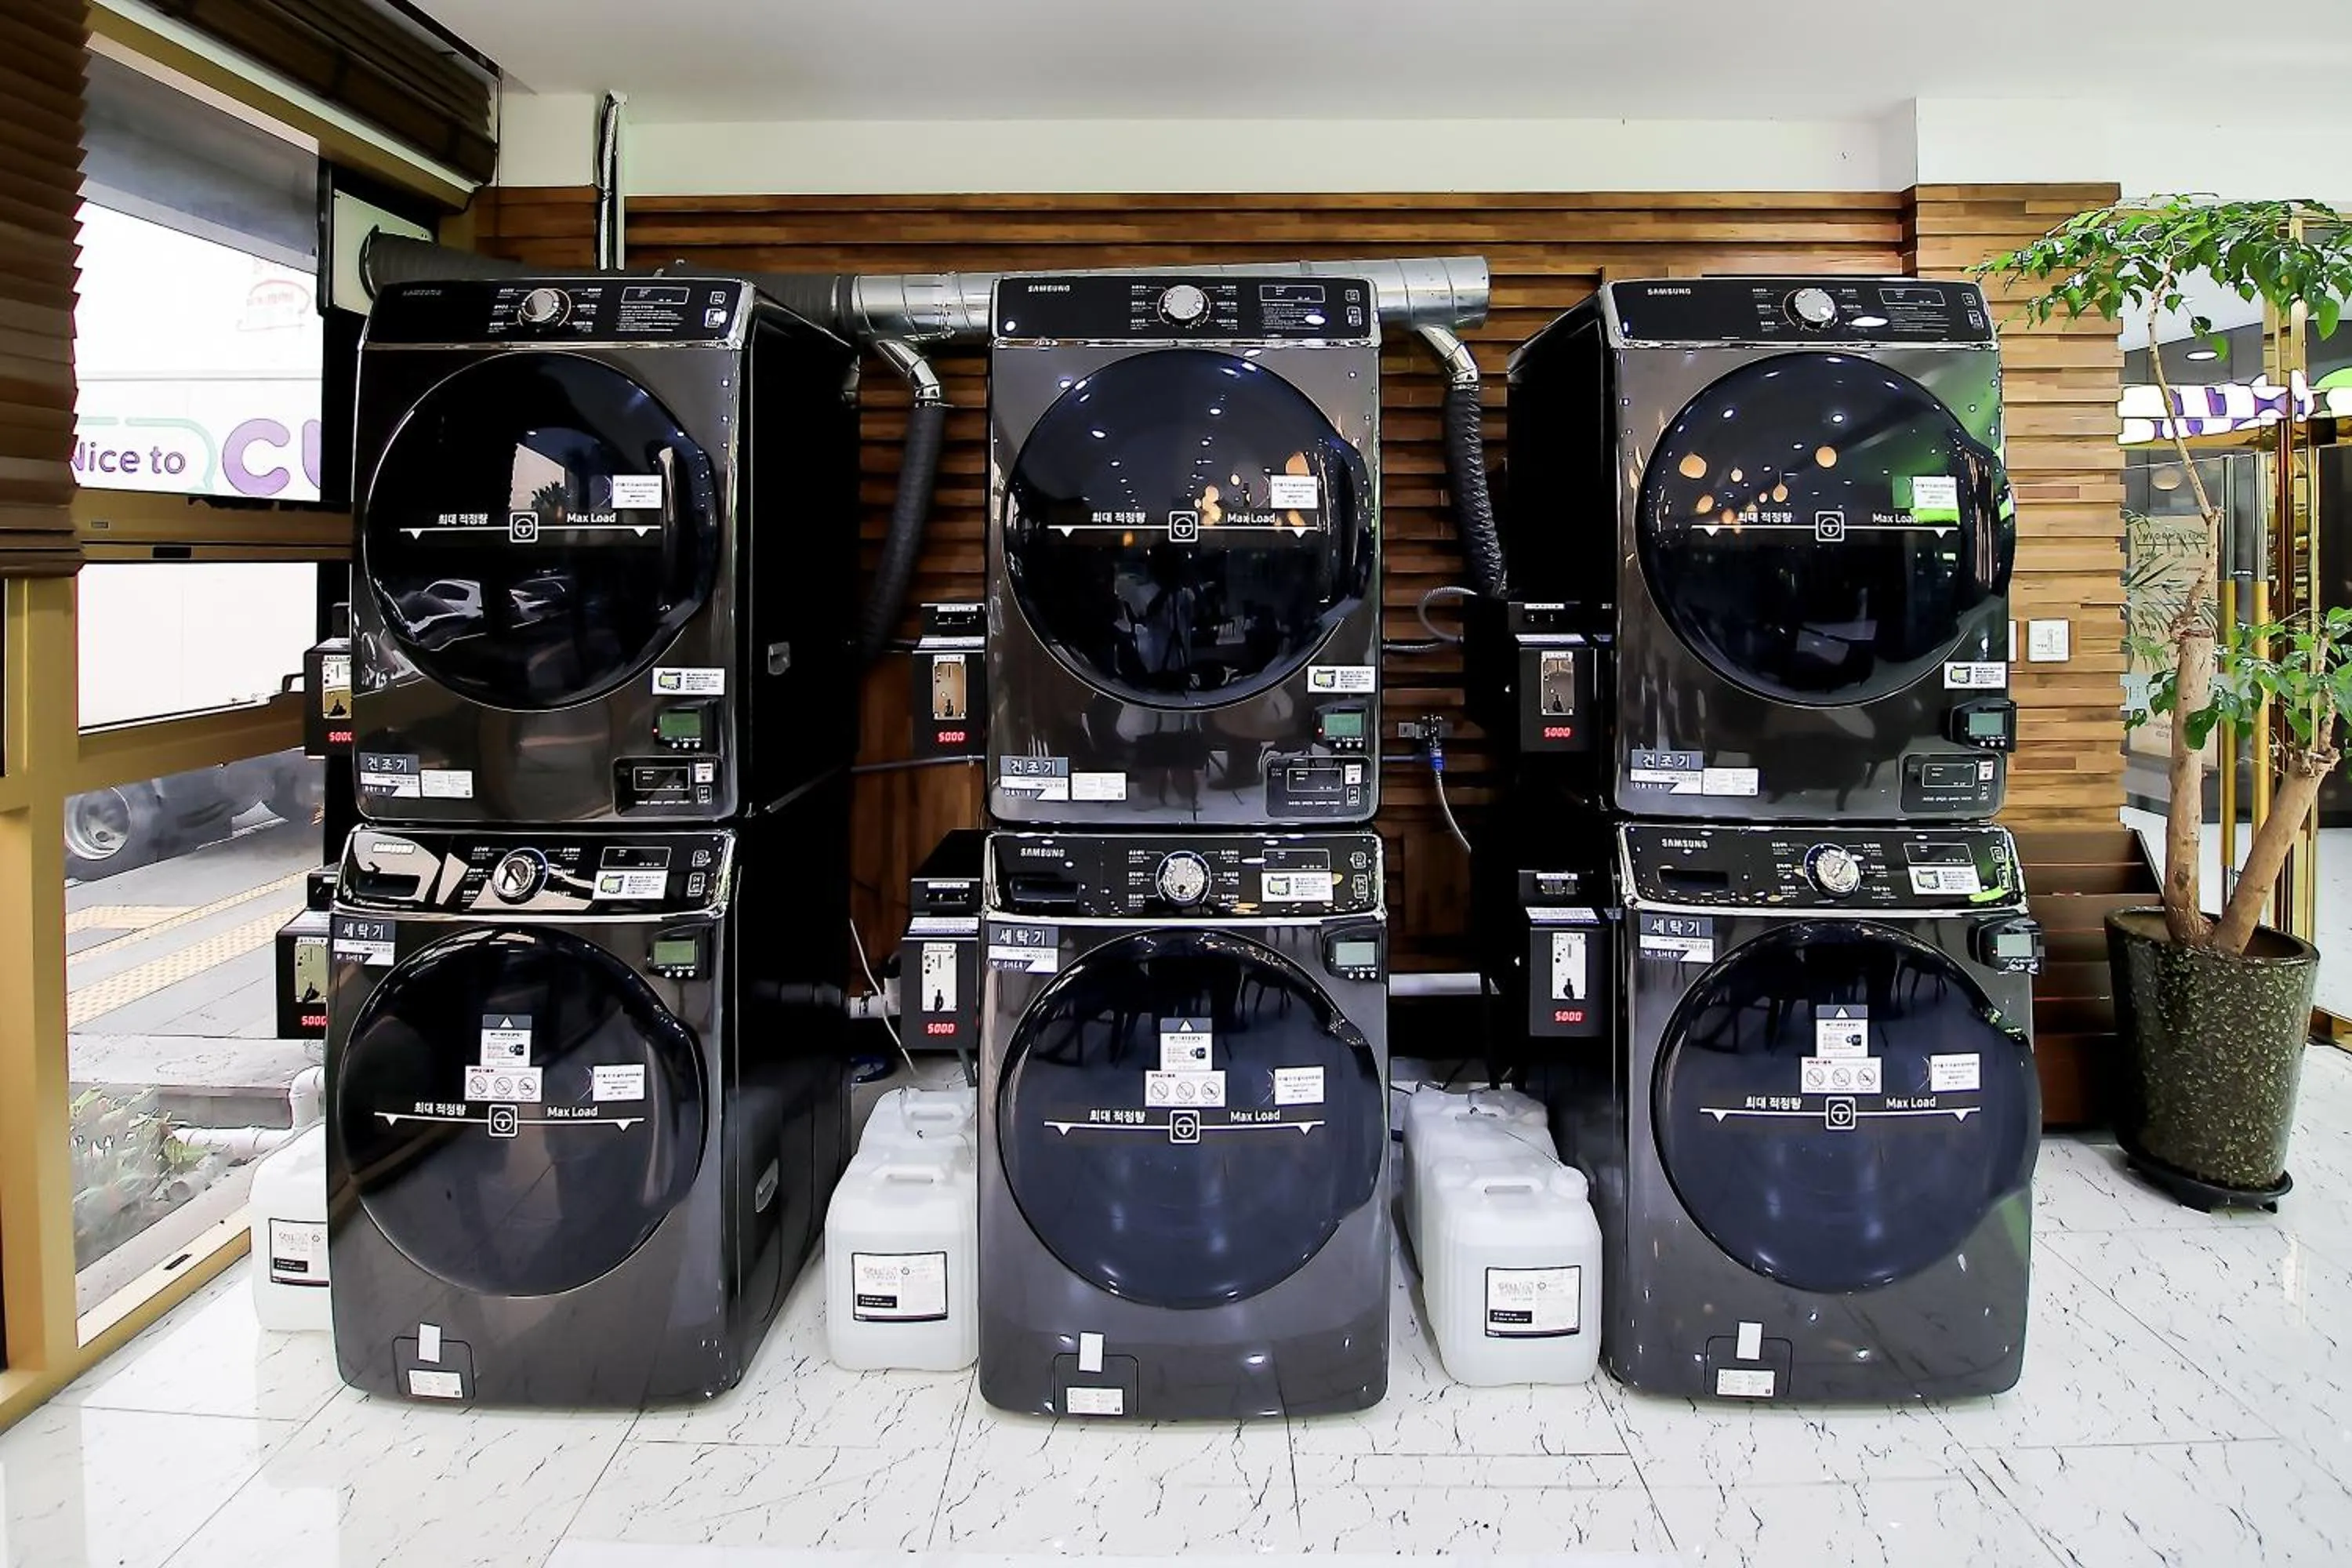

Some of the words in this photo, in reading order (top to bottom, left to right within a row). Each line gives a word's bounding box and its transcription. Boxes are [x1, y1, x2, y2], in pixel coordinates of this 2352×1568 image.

[1028, 285, 1070, 293] SAMSUNG
[151, 446, 186, 474] to
[438, 514, 457, 525] 최대
[459, 514, 488, 525] 적정량
[567, 514, 589, 523] Max
[591, 513, 617, 523] Load
[1092, 512, 1112, 524] 최대
[1115, 512, 1146, 524] 적정량
[1228, 513, 1250, 523] Max
[1250, 513, 1276, 524] Load
[1759, 512, 1793, 524] 적정량
[1873, 514, 1894, 523] Max
[1895, 512, 1918, 524] Load
[938, 731, 965, 742] 5000
[1544, 727, 1571, 738] 5000
[368, 757, 407, 773] 건조기
[1642, 753, 1690, 769] 건조기
[1011, 760, 1055, 775] 건조기
[1661, 838, 1708, 849] SAMSUNG
[1020, 848, 1065, 858] SAMSUNG
[342, 921, 385, 939] 세탁기
[1650, 919, 1701, 937] 세탁기
[999, 927, 1047, 946] 세탁기
[302, 1015, 327, 1026] 5000
[1555, 1011, 1583, 1022] 5000
[927, 1023, 955, 1034] 5000
[1745, 1096, 1766, 1109] 최대
[1769, 1097, 1802, 1110] 적정량
[1886, 1098, 1909, 1109] Max
[1911, 1096, 1936, 1109] Load
[414, 1102, 434, 1114] 최대
[435, 1103, 466, 1116] 적정량
[546, 1107, 570, 1117] Max
[572, 1105, 598, 1117] Load
[1089, 1109, 1111, 1122] 최대
[1113, 1110, 1146, 1123] 적정량
[1230, 1112, 1253, 1122] Max
[1255, 1109, 1281, 1122] Load
